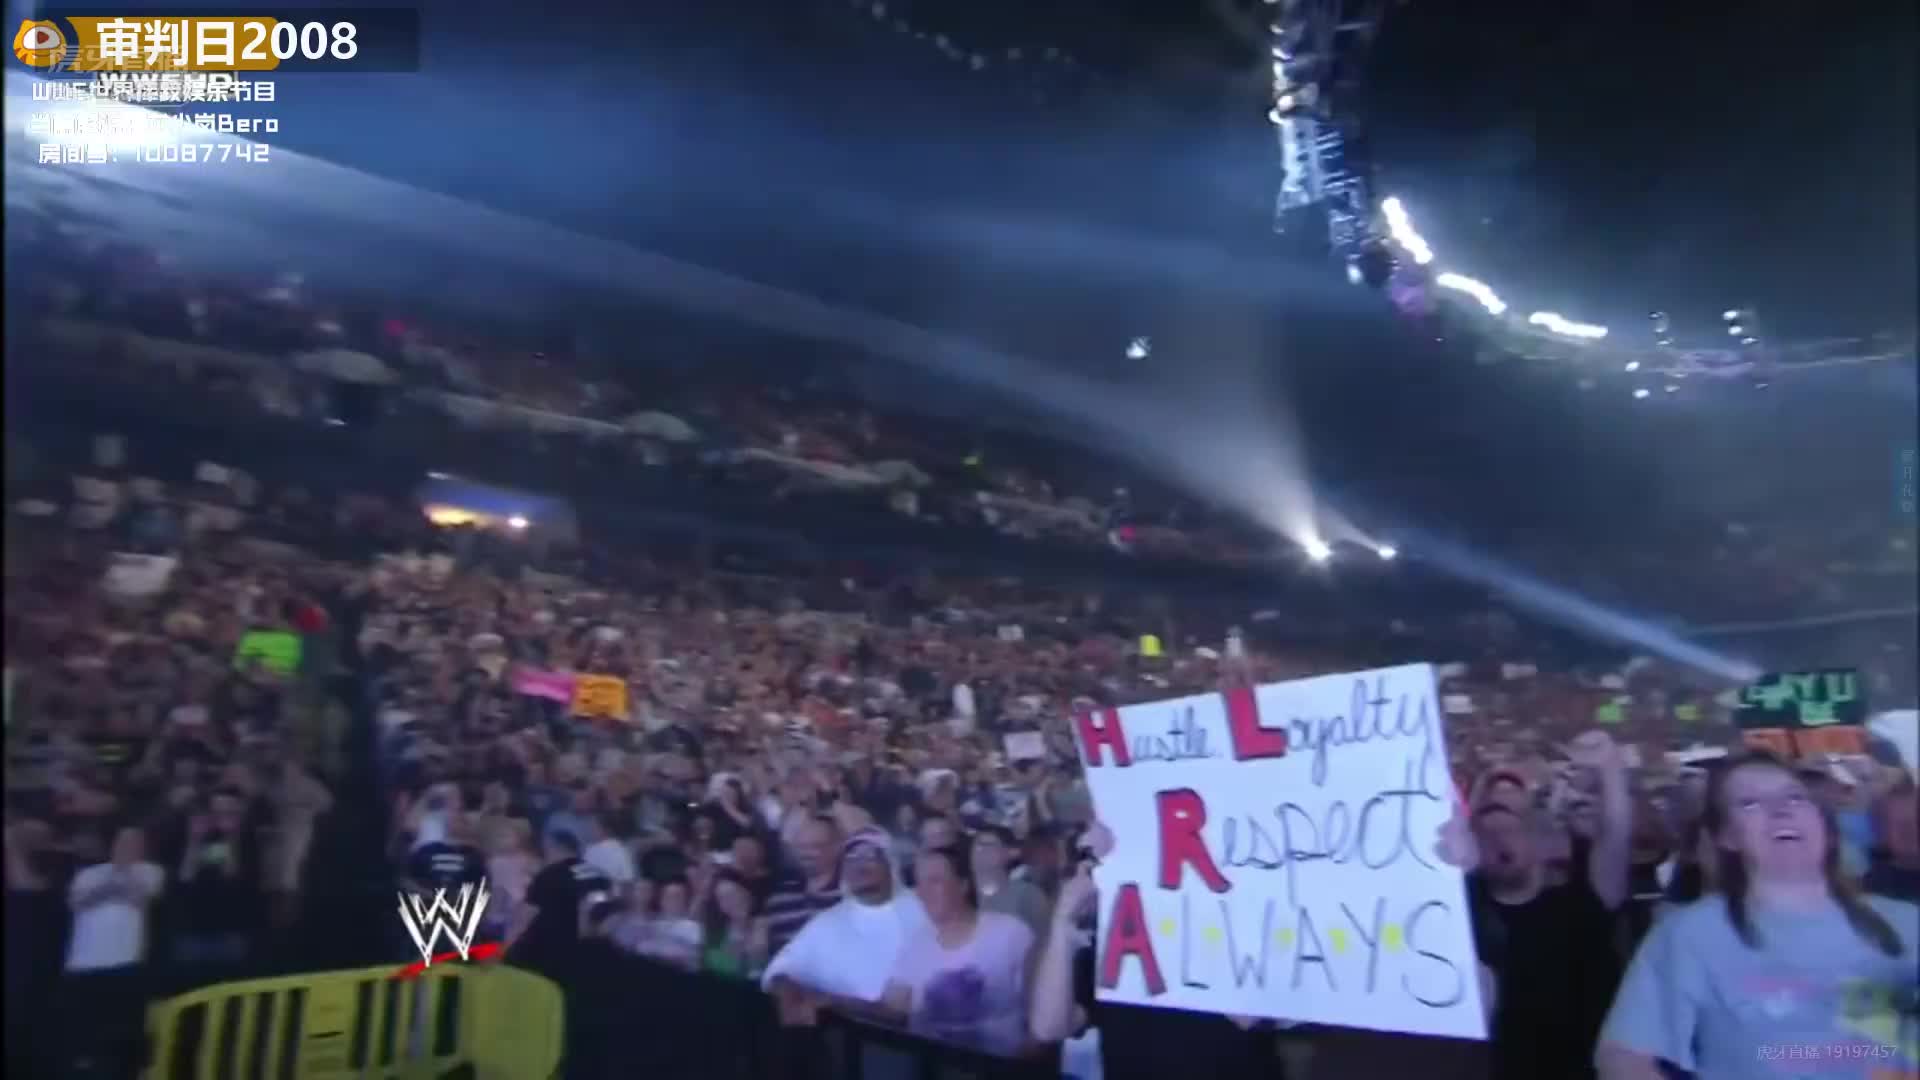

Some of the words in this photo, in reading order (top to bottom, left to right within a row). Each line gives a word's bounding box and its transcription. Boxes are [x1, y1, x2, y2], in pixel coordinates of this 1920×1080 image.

[1221, 679, 1438, 791] Loyalty
[1155, 760, 1440, 907] Respect
[1100, 883, 1465, 1008] ALWAYS
